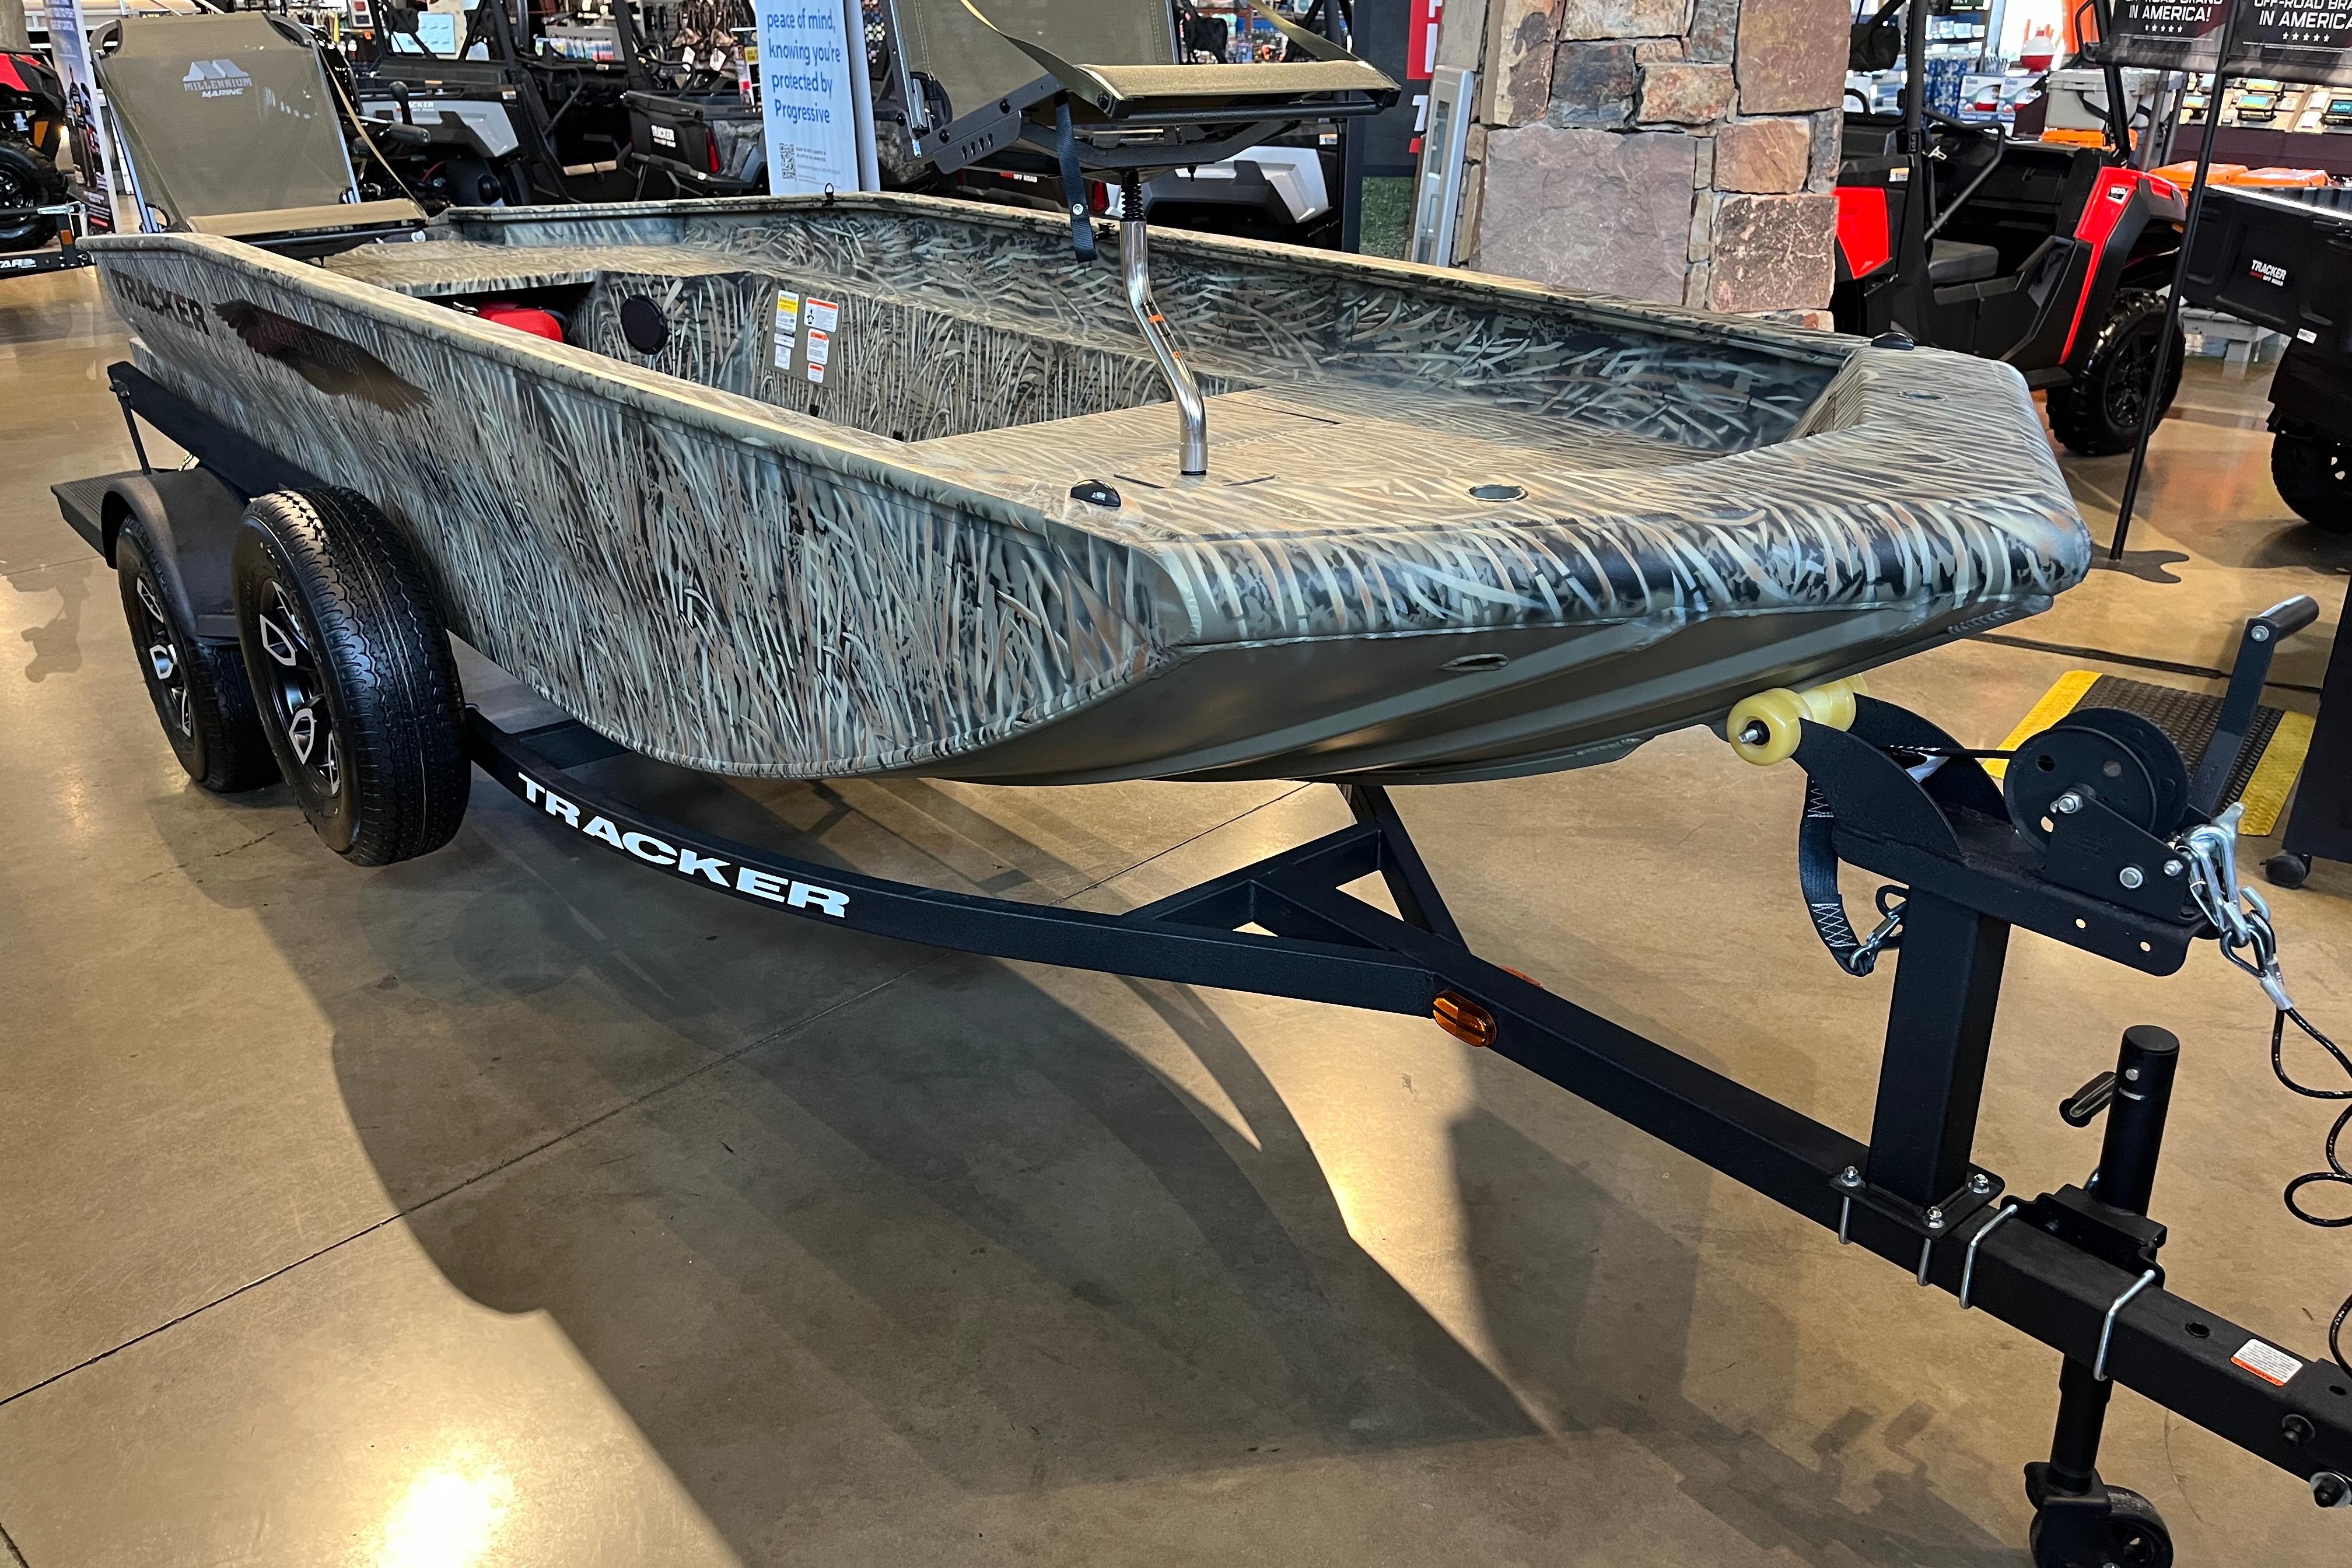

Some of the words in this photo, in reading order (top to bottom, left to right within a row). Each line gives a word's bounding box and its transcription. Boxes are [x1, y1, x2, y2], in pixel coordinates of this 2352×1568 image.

[767, 13, 794, 33] peace
[797, 8, 805, 29] of
[808, 8, 835, 33] mind,
[2129, 5, 2138, 19] IN
[2142, 5, 2211, 22] AMERICA!
[2259, 10, 2275, 26] IN
[768, 38, 810, 65] knowing
[813, 40, 840, 66] you're
[183, 77, 253, 91] MILLENNIUM
[202, 88, 243, 98] MARINE
[771, 71, 818, 93] protected
[821, 72, 832, 99] by
[775, 99, 830, 124] Progressive
[2252, 260, 2287, 280] TRACKER
[108, 267, 212, 337] TRACKER
[518, 772, 850, 918] TRACKER
